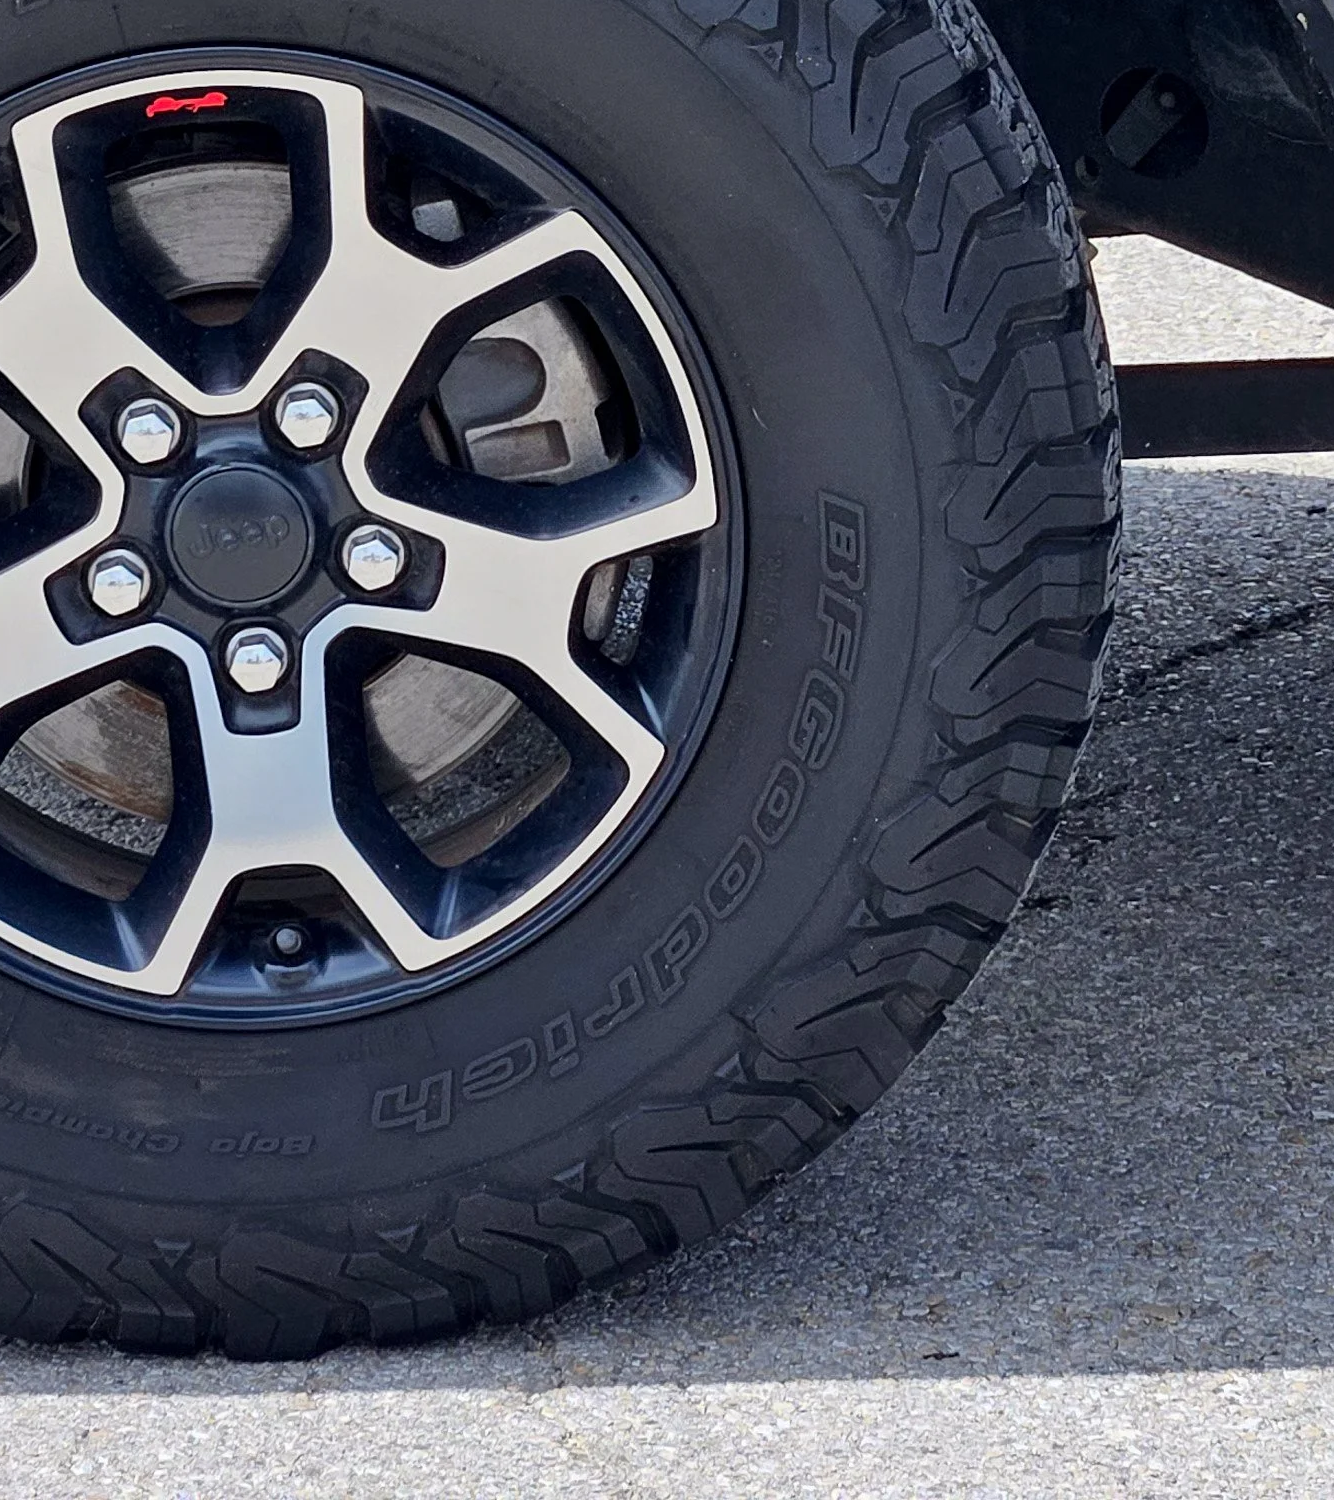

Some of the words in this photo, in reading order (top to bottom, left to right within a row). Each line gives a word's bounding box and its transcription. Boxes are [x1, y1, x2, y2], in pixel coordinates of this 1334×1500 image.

[187, 513, 291, 559] Jeep
[369, 488, 869, 1133] BFGoodrich
[205, 1128, 315, 1157] Baja
